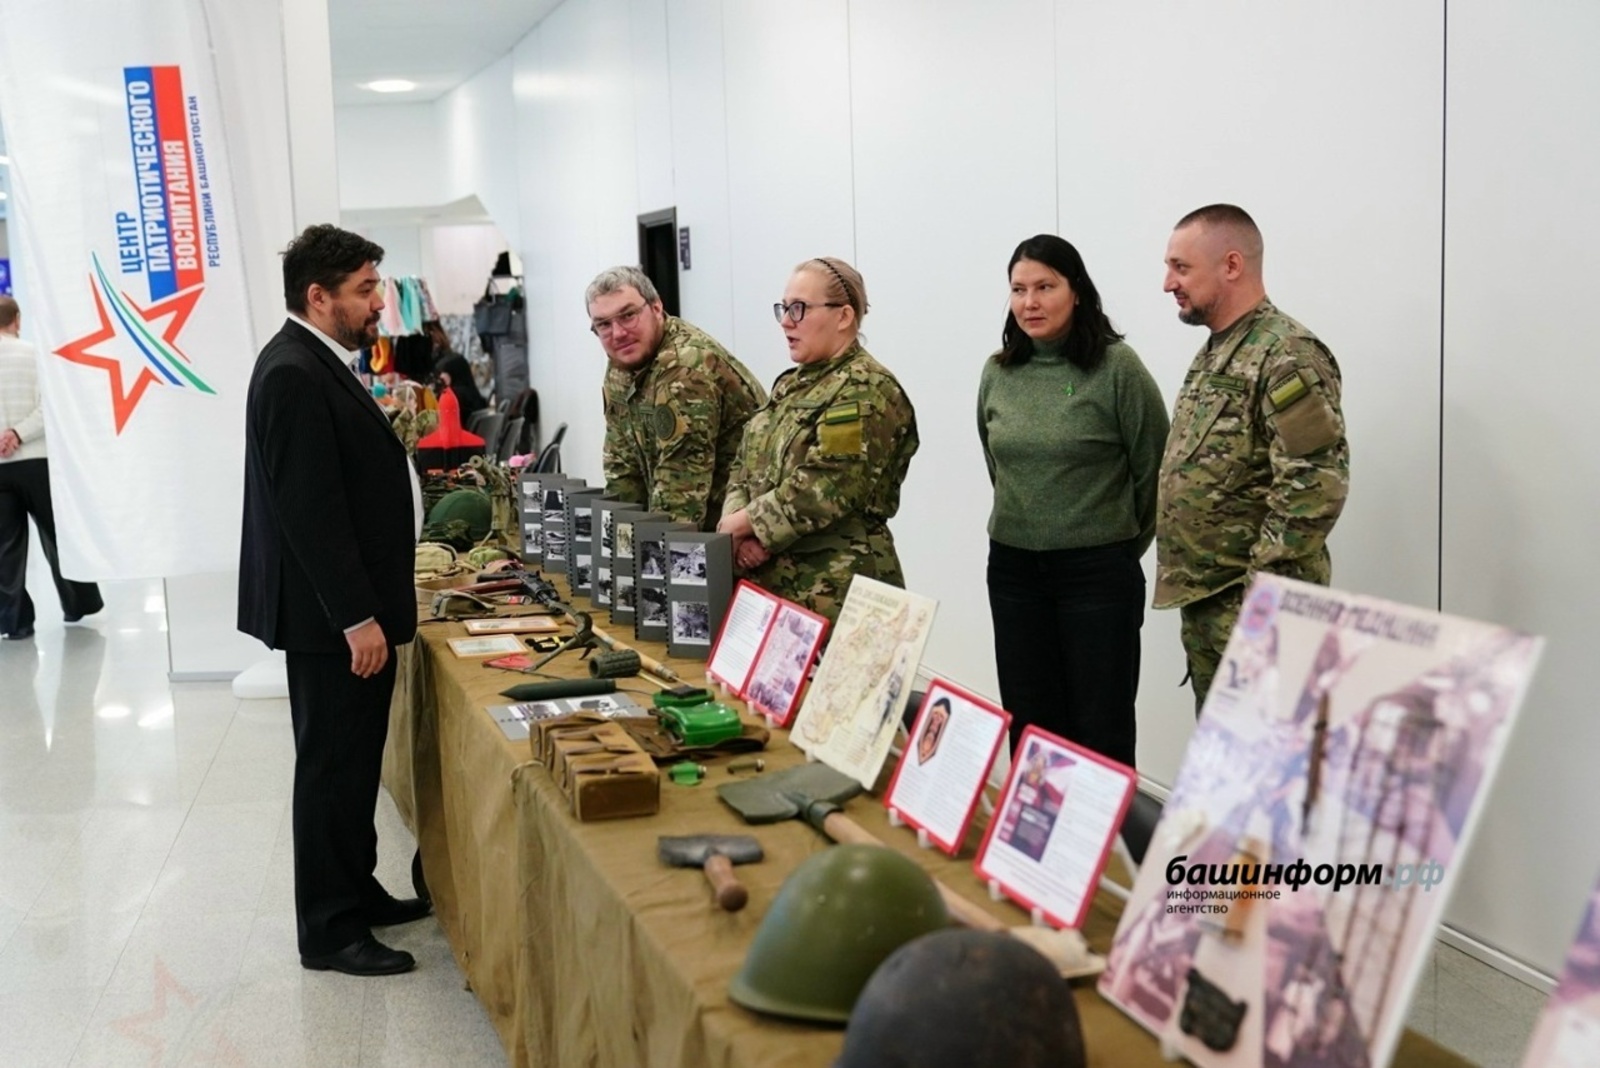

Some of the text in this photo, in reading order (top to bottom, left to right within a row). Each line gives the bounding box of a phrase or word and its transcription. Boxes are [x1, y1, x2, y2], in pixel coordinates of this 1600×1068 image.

[115, 212, 144, 273] ЦЕНТР
[127, 80, 172, 272] ПАТРИОТИЧЕСКОГО
[161, 140, 199, 270] ВОСПИТАНИЯ
[187, 95, 220, 267] РЕСПУБЛИКИ БАШКОРТОСТАН
